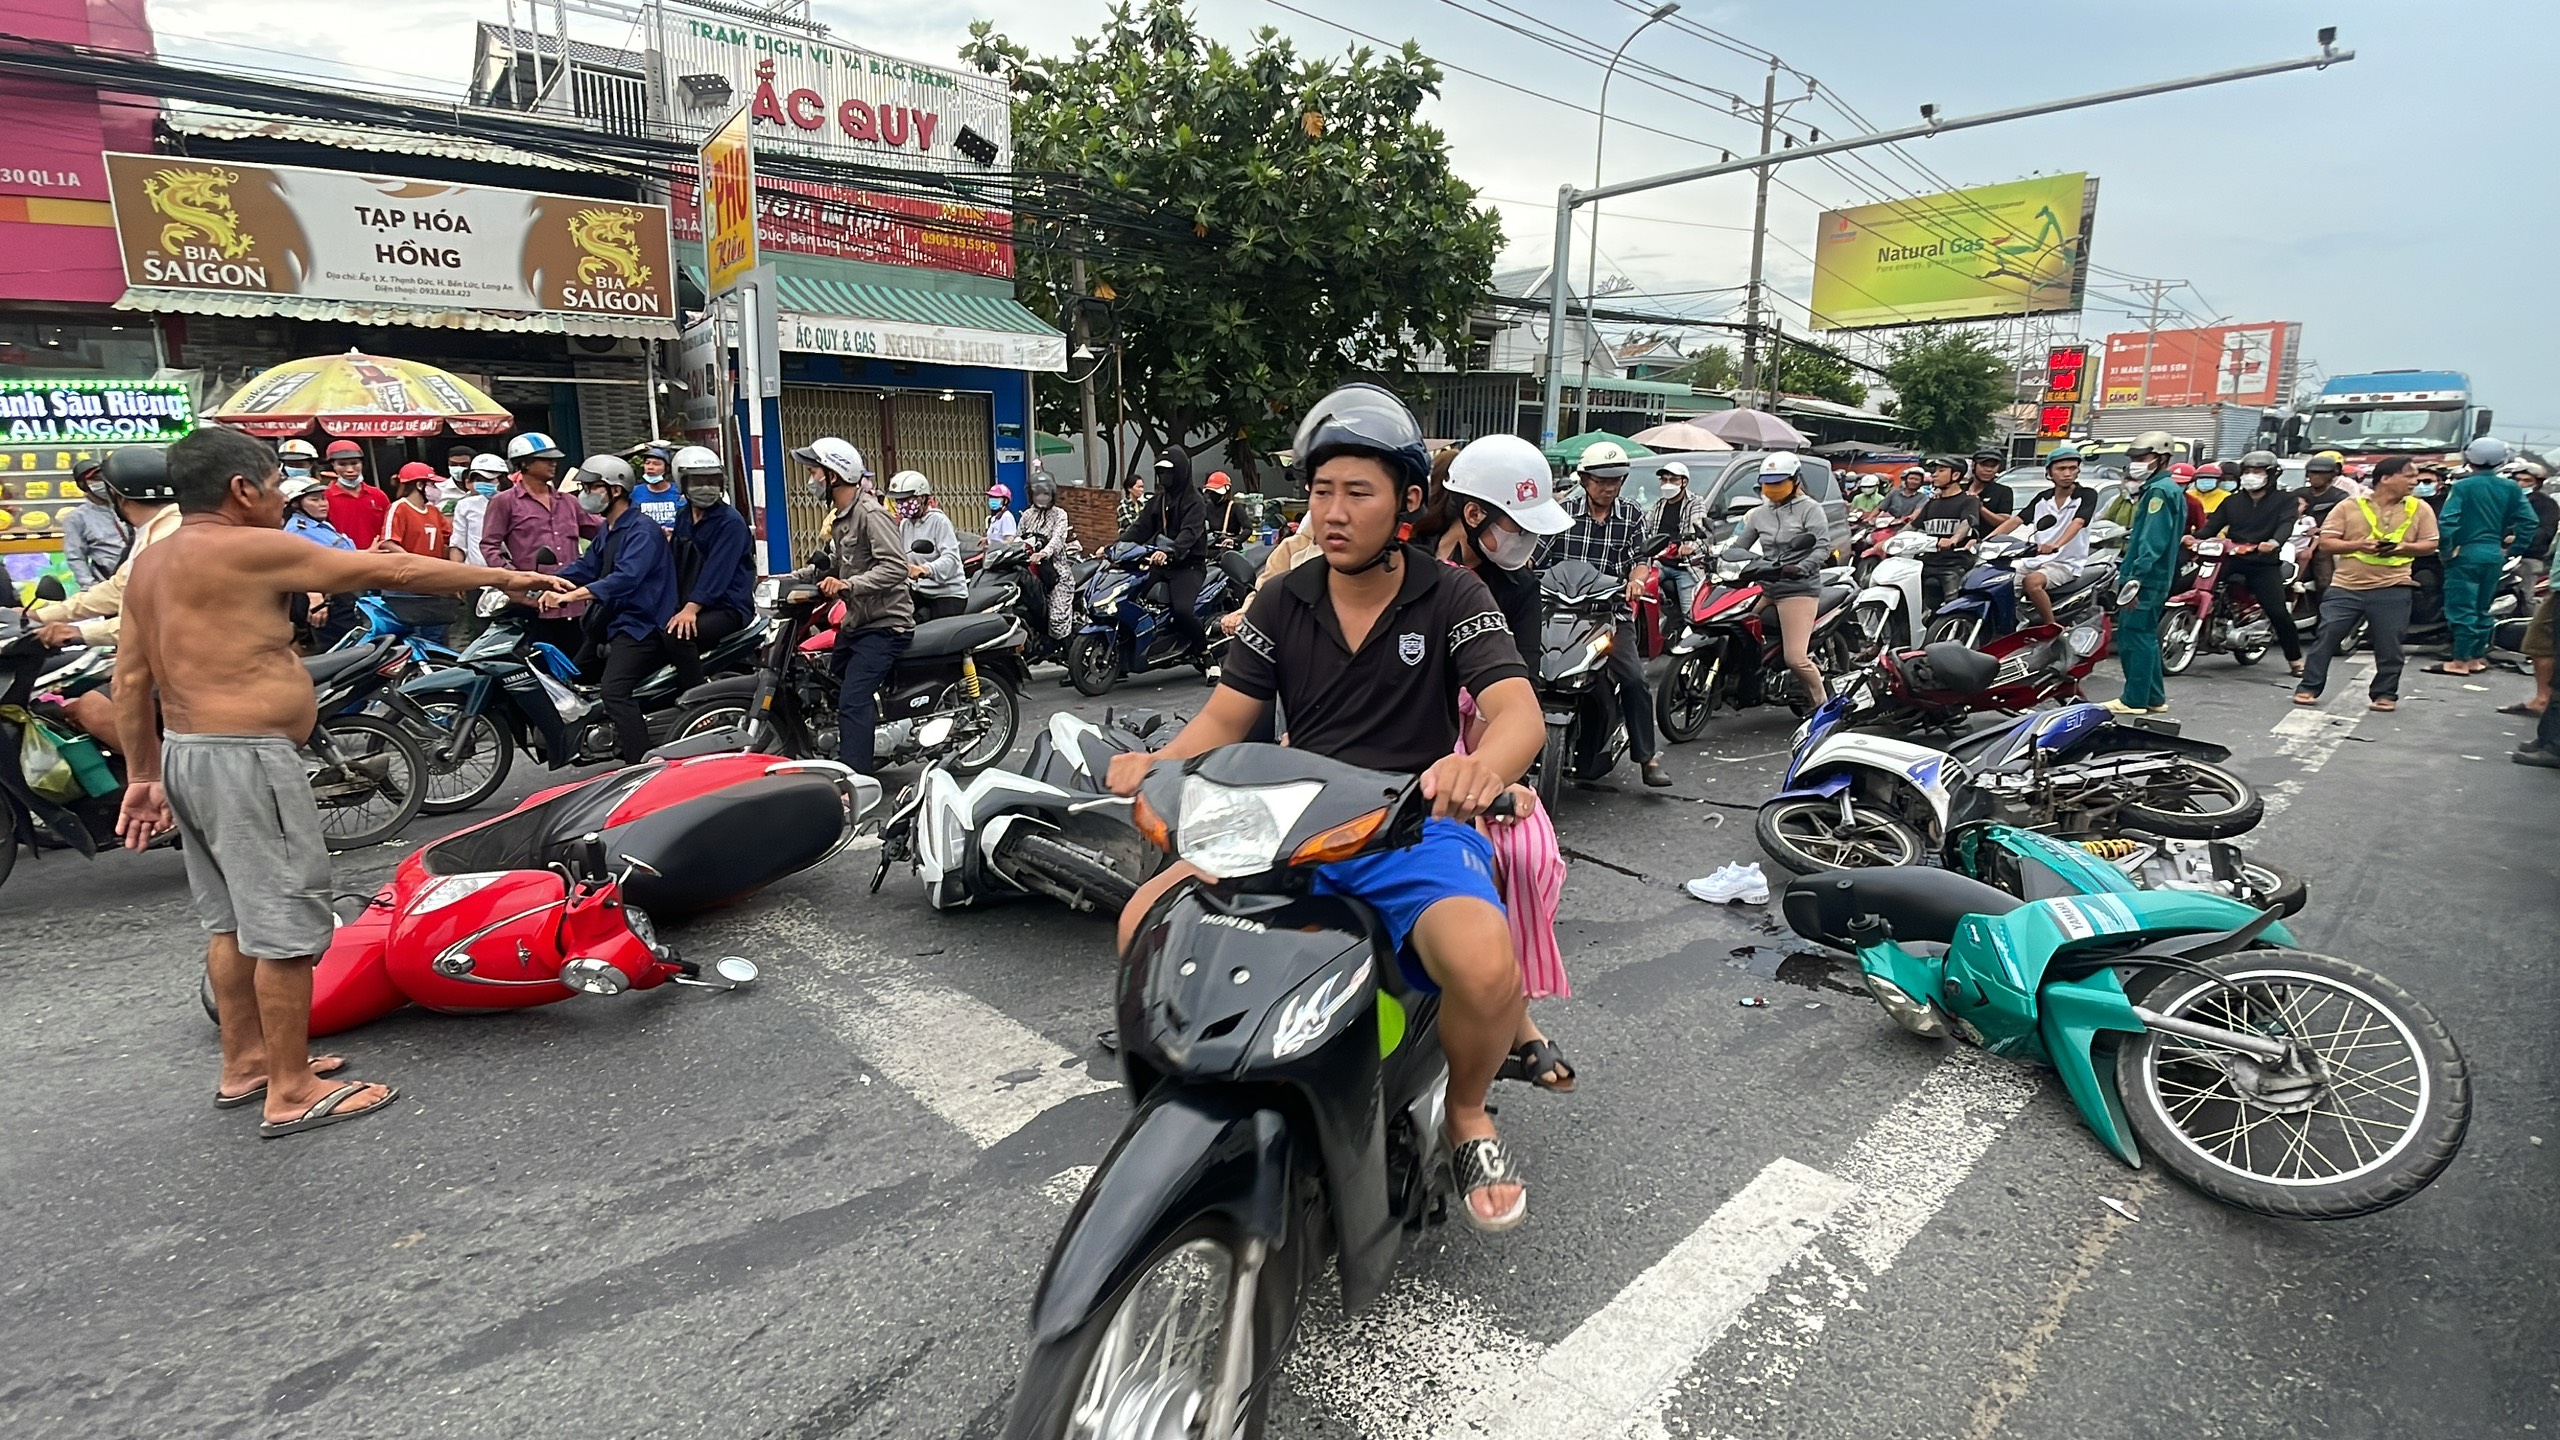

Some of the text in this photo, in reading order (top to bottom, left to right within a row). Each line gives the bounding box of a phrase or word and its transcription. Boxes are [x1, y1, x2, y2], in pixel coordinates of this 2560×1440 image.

[689, 20, 748, 48] TRẠM
[753, 34, 801, 59] DỊCH
[837, 98, 938, 151] QUY
[27, 168, 81, 187] QL1A
[354, 206, 473, 234] TẠP HÓA
[184, 245, 222, 262] BIA
[375, 239, 462, 268] HỒNG
[1877, 237, 1944, 263] Natural
[1949, 236, 1985, 255] Gas
[143, 258, 267, 288] SAIGON
[595, 276, 625, 290] BIA
[482, 281, 501, 292] Long
[502, 283, 514, 291] An
[562, 287, 658, 313] SAIGON
[815, 326, 838, 353] QUY
[842, 329, 852, 353] &
[853, 330, 876, 355] GAS
[50, 387, 104, 418] Sầu
[104, 390, 185, 420] Riêng
[64, 417, 161, 437] NGON
[424, 526, 437, 551] 7
[502, 671, 530, 683] YAMAHA
[1199, 913, 1267, 935] HONDA
